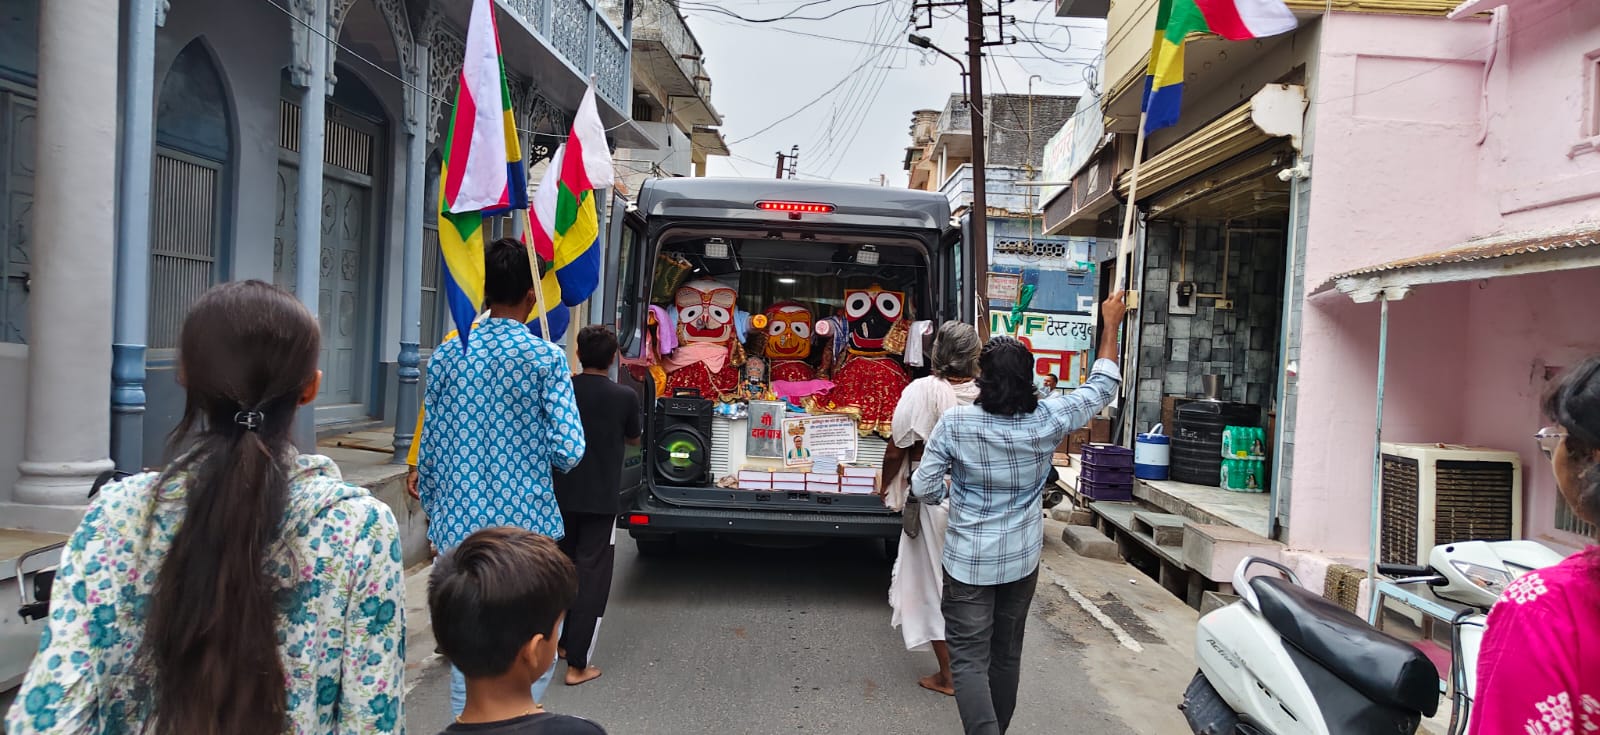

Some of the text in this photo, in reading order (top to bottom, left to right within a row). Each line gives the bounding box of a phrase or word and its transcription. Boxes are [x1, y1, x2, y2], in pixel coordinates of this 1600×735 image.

[991, 313, 1046, 335] IVF
[1046, 317, 1070, 336] टेस्ट
[751, 428, 766, 439] दान
[1206, 639, 1239, 669] Activa
